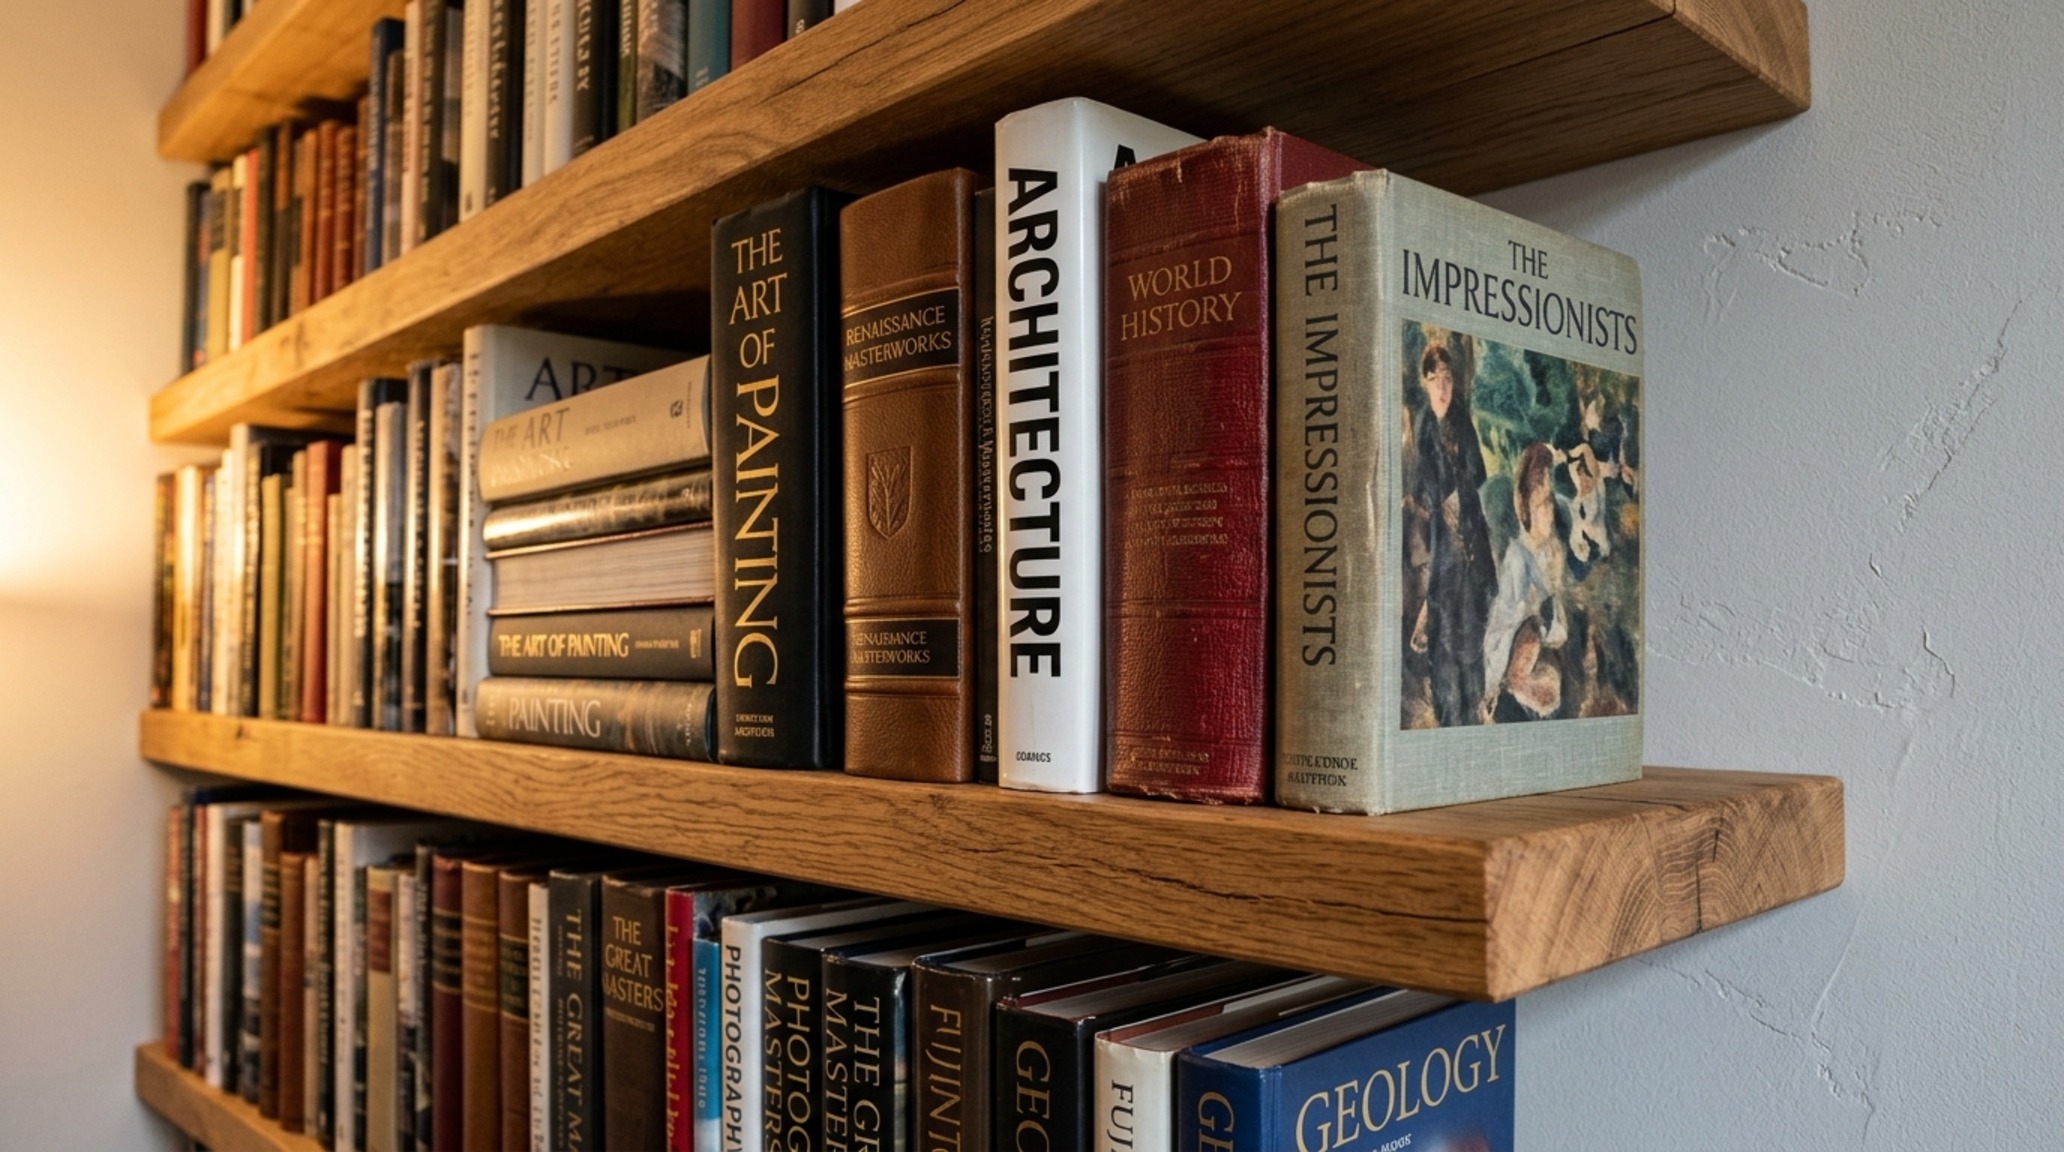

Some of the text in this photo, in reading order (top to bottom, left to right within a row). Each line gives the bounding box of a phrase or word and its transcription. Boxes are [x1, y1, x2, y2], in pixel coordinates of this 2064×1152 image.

[731, 228, 783, 274] THE
[1508, 240, 1549, 280] THE
[729, 273, 788, 326] ART
[1128, 256, 1232, 302] WORLD
[1402, 249, 1639, 356] IMPRESSIONISTS
[846, 305, 946, 346] RENAISSANCE
[1121, 291, 1242, 342] HISTORY
[740, 328, 775, 369] OF
[522, 407, 570, 451] ART
[1008, 167, 1062, 678] ARCHITECTURE
[1302, 204, 1340, 667] THE IMPRESSIONISTS
[734, 374, 780, 689] PAINTING
[498, 632, 630, 659] THE ART OF PAINTING
[508, 697, 602, 739] PAINTING
[565, 909, 583, 982] THE
[612, 916, 642, 946] THE
[604, 943, 653, 978] GREAT
[565, 992, 584, 1106] GREAT
[786, 976, 811, 1152] PHOTOG
[853, 997, 881, 1087] THE
[1295, 1024, 1507, 1152] GEOLOGY
[1111, 1080, 1134, 1152] FUJ
